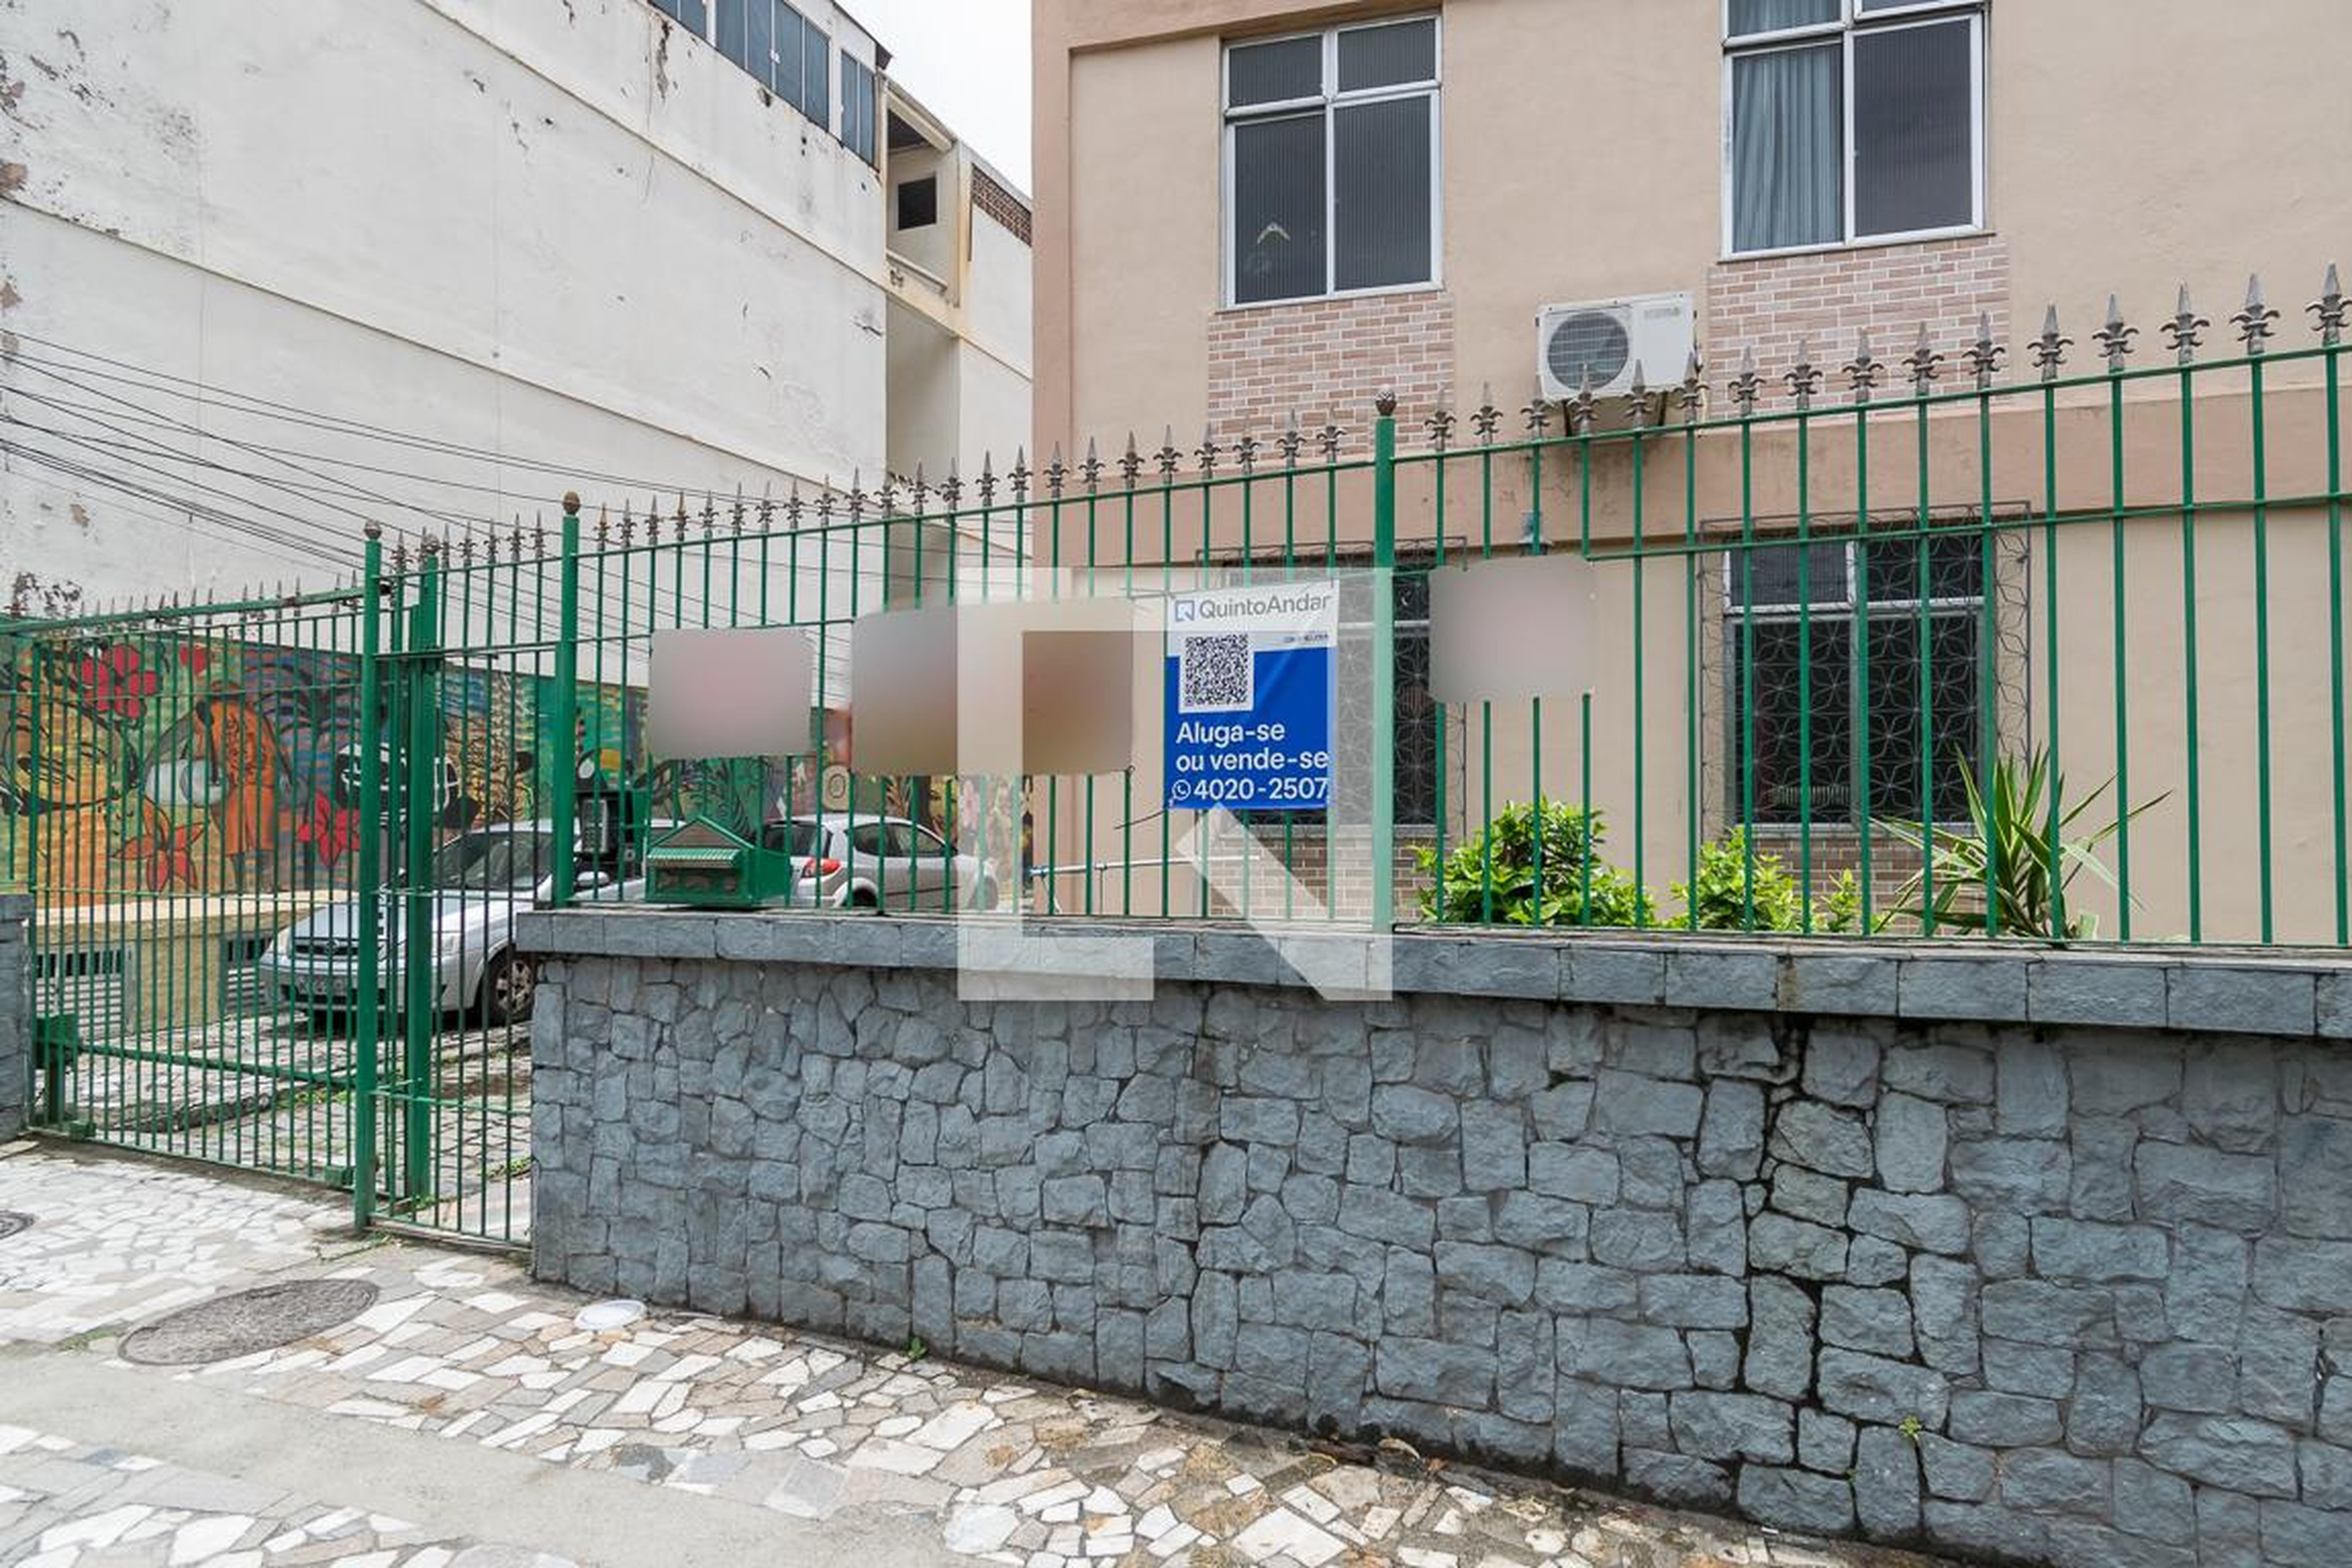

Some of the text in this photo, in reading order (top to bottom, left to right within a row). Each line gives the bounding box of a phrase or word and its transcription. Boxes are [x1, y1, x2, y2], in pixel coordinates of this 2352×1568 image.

[1199, 593, 1332, 619] QuintoAndar
[1175, 722, 1286, 748] Aluga-se
[1175, 747, 1329, 772] ou vende-se
